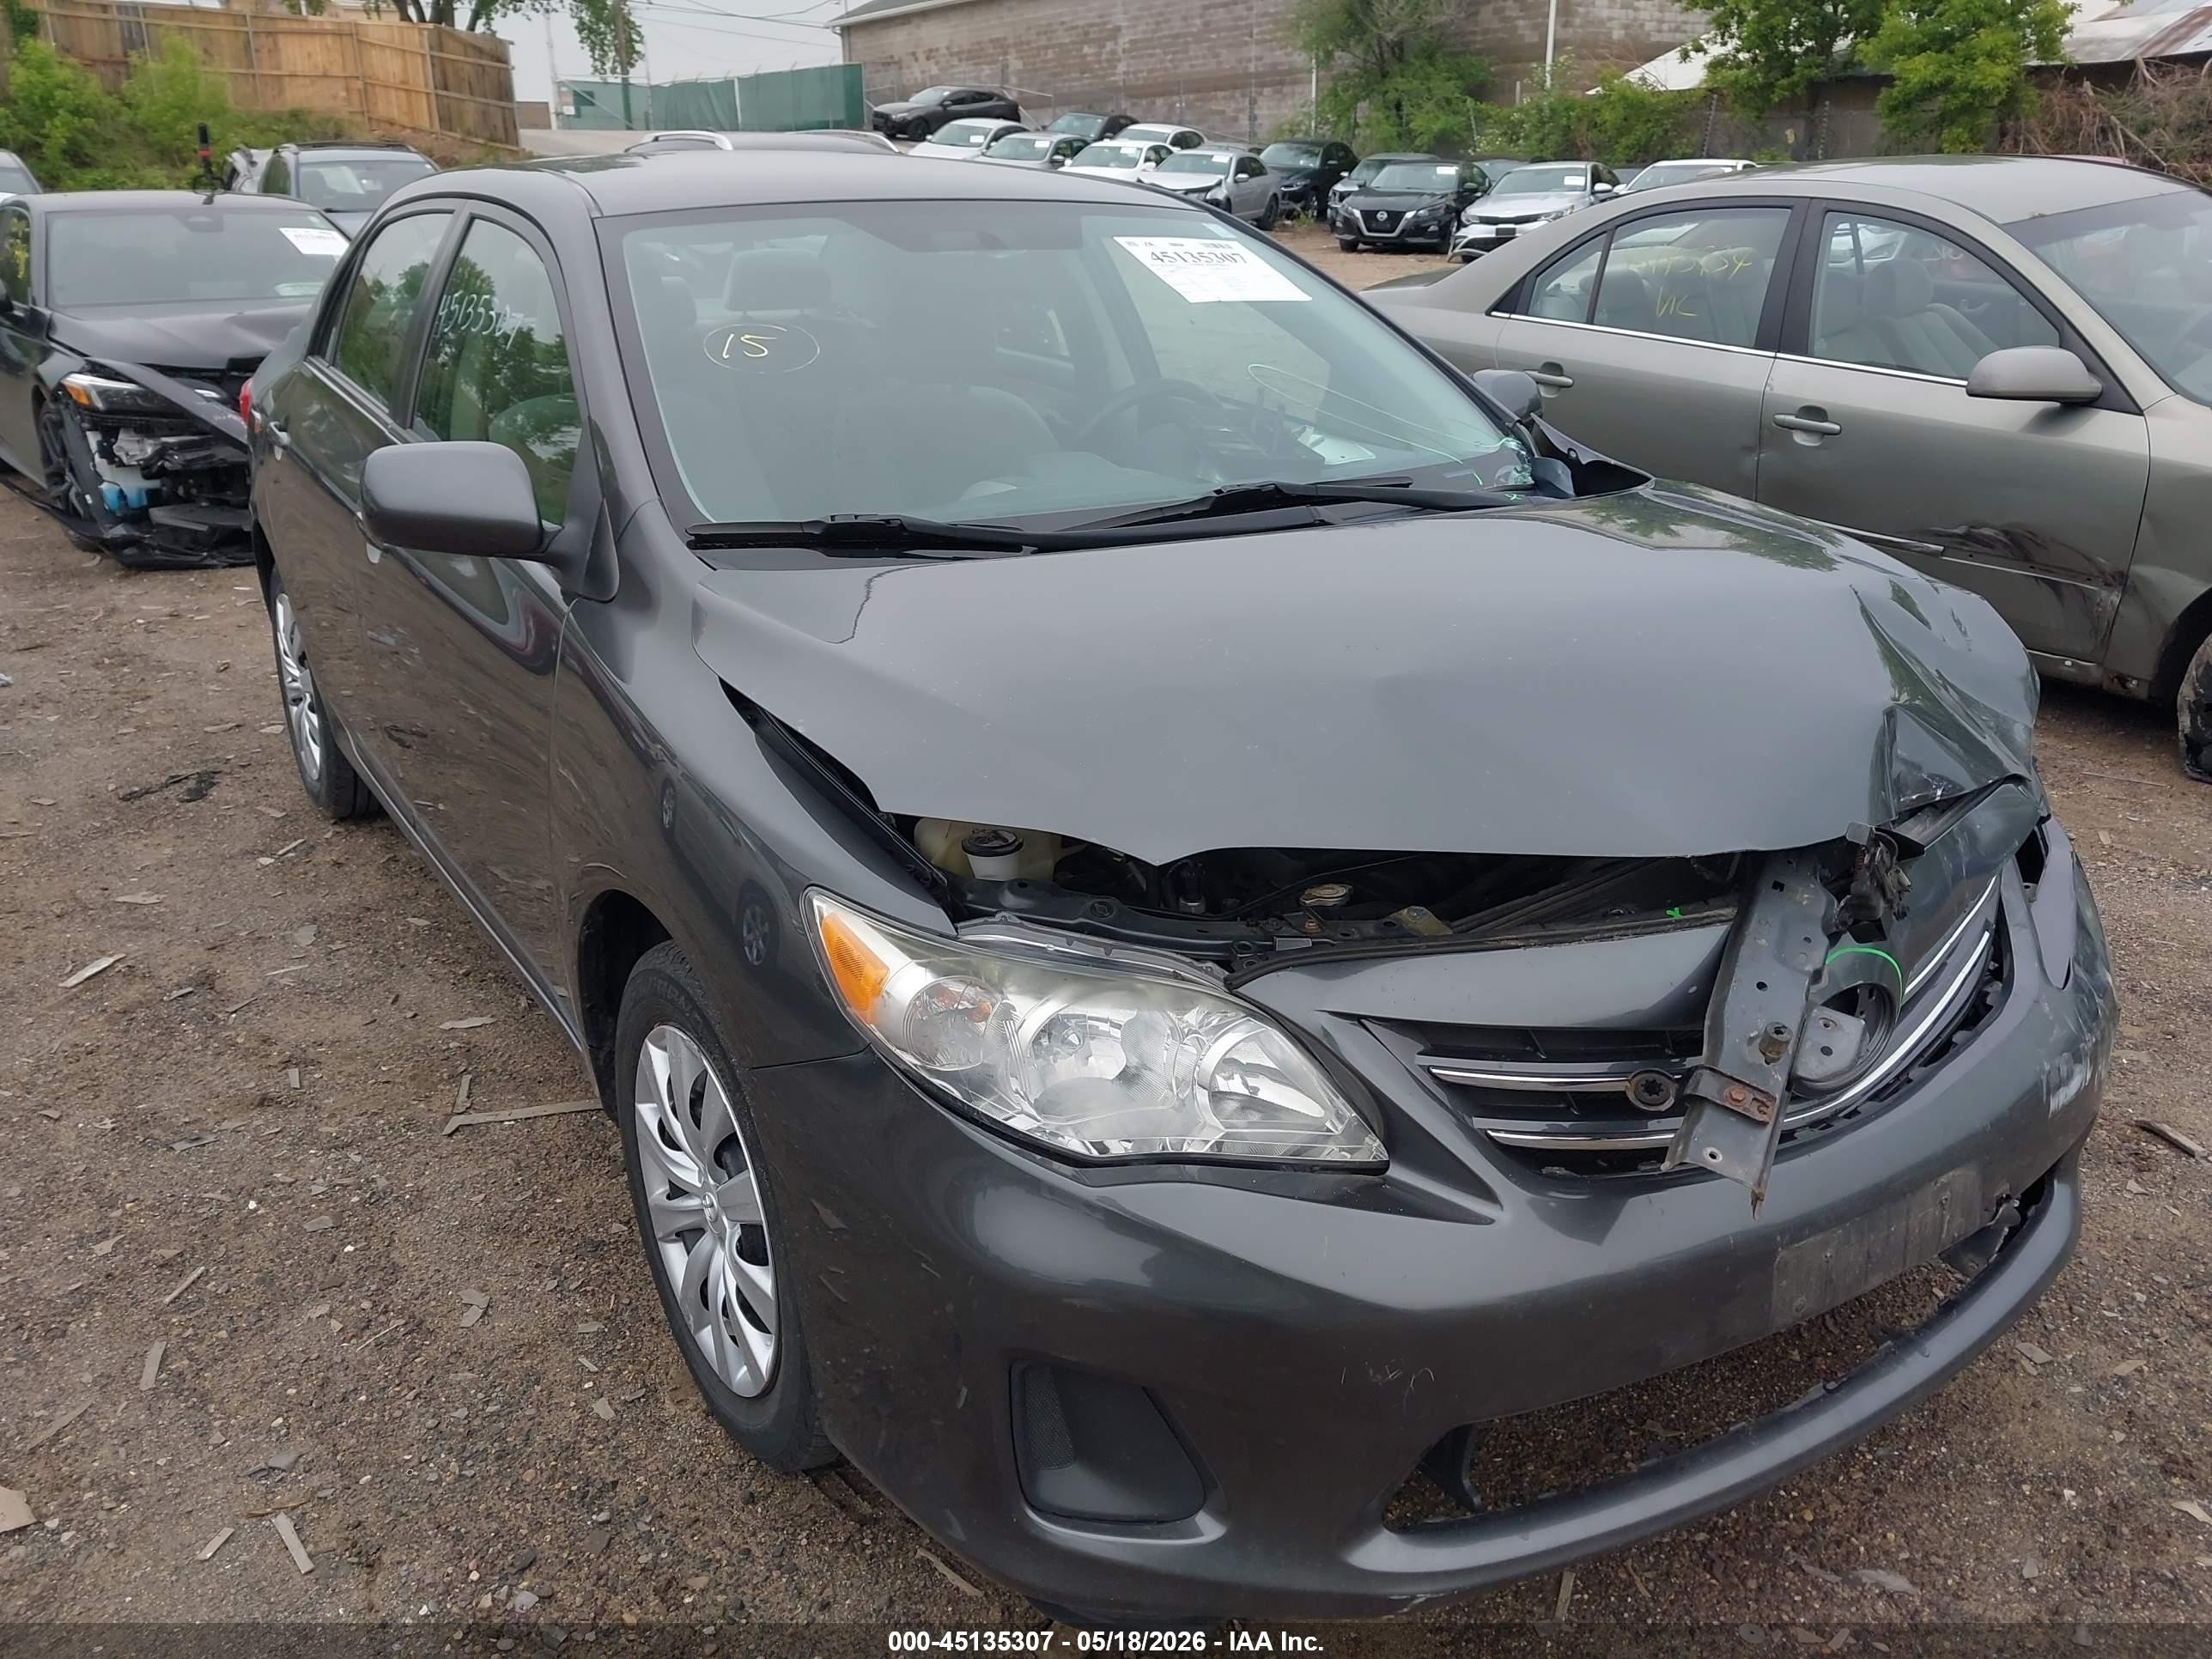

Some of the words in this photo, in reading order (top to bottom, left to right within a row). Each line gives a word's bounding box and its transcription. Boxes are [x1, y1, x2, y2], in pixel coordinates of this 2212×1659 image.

[1150, 251, 1248, 264] 45135307
[437, 289, 526, 351] 45135307
[722, 333, 777, 359] 15
